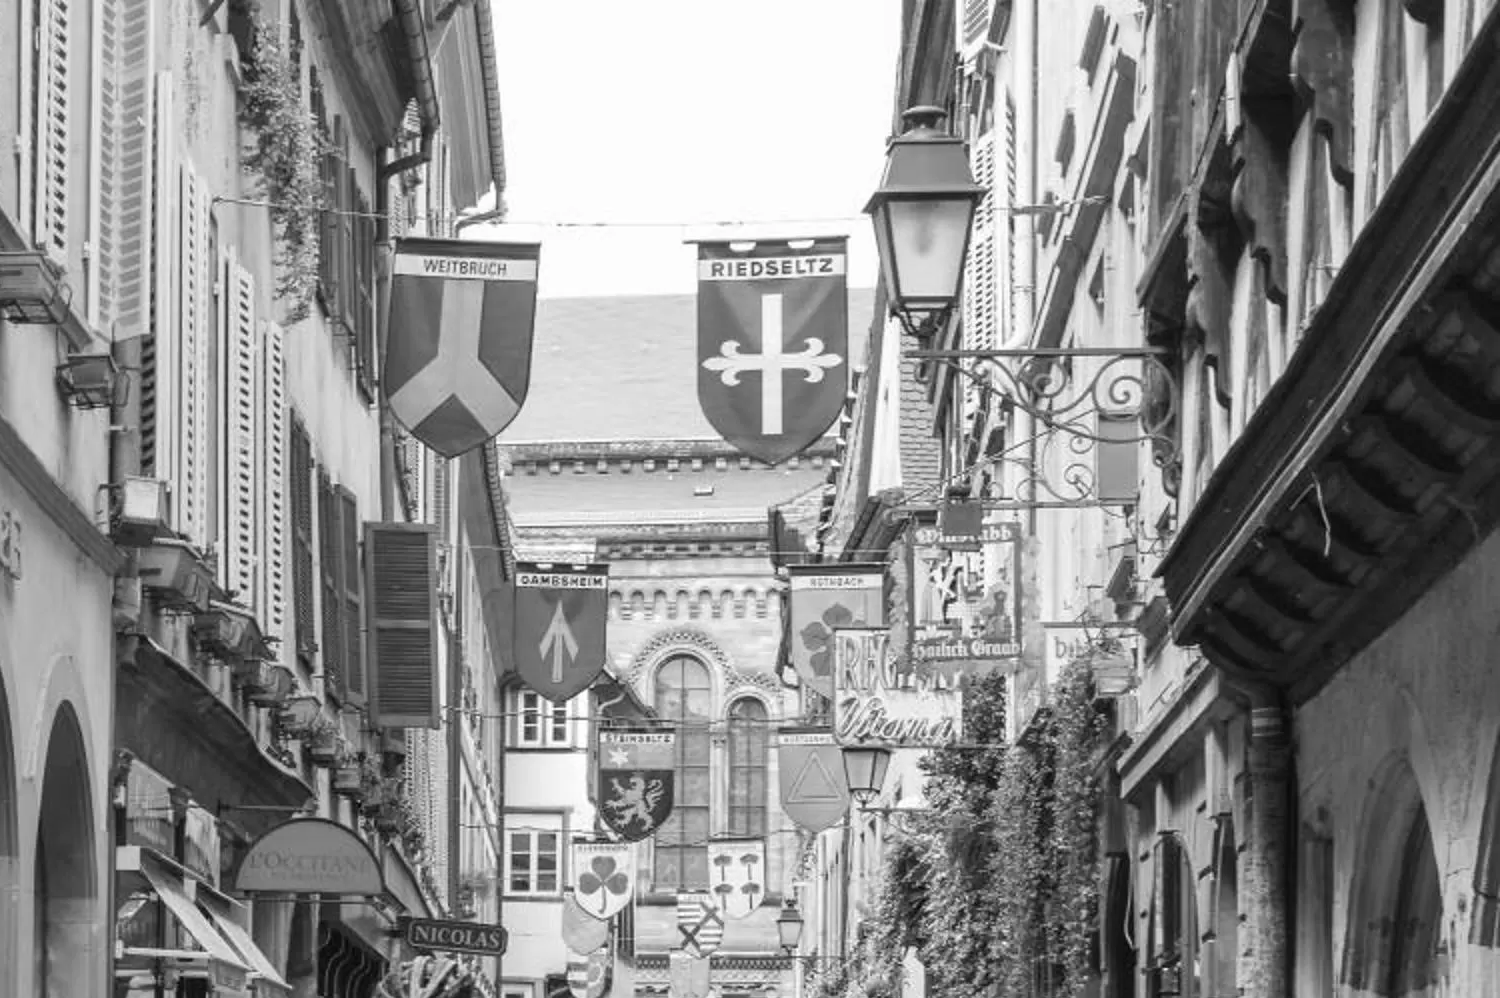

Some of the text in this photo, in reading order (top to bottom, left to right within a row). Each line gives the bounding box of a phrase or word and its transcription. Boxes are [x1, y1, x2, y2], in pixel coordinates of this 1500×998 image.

[424, 259, 507, 276] WEITBRUCH
[711, 258, 833, 277] RIEDSELTZ
[415, 926, 499, 948] NICOLAS
